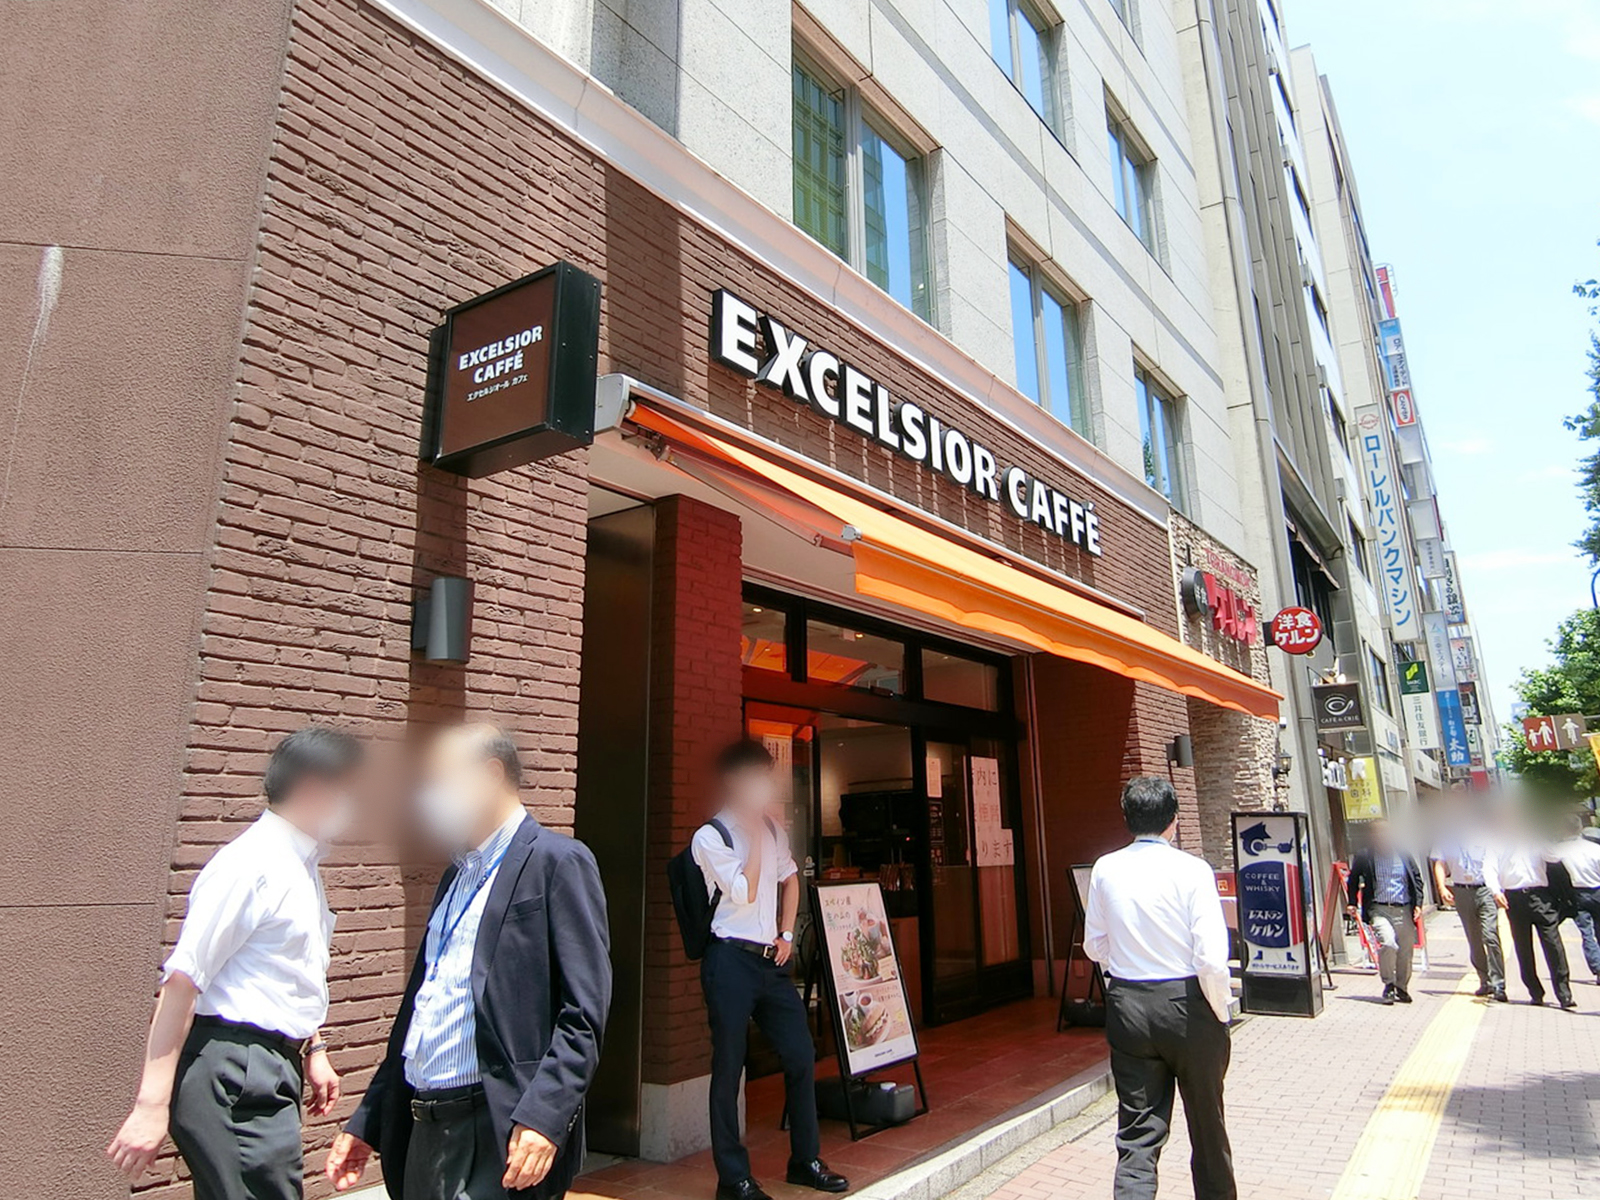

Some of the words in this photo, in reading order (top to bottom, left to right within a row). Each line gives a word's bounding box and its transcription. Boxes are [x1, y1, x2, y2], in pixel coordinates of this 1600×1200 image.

[459, 325, 543, 370] EXCELSIOR
[473, 349, 524, 384] CAFFÉ
[716, 291, 998, 500] EXCELSIOR
[1004, 466, 1101, 556] CAFFÉ
[1364, 434, 1411, 626] ローレルバンクマシン
[1278, 611, 1313, 630] 洋食
[1275, 628, 1319, 646] ケルン
[1413, 695, 1428, 746] 三井住友銀行
[1245, 872, 1280, 881] COFFEE
[1245, 884, 1280, 893] WHISKY
[1249, 909, 1284, 921] レストラン
[1250, 924, 1285, 938] ケルン
